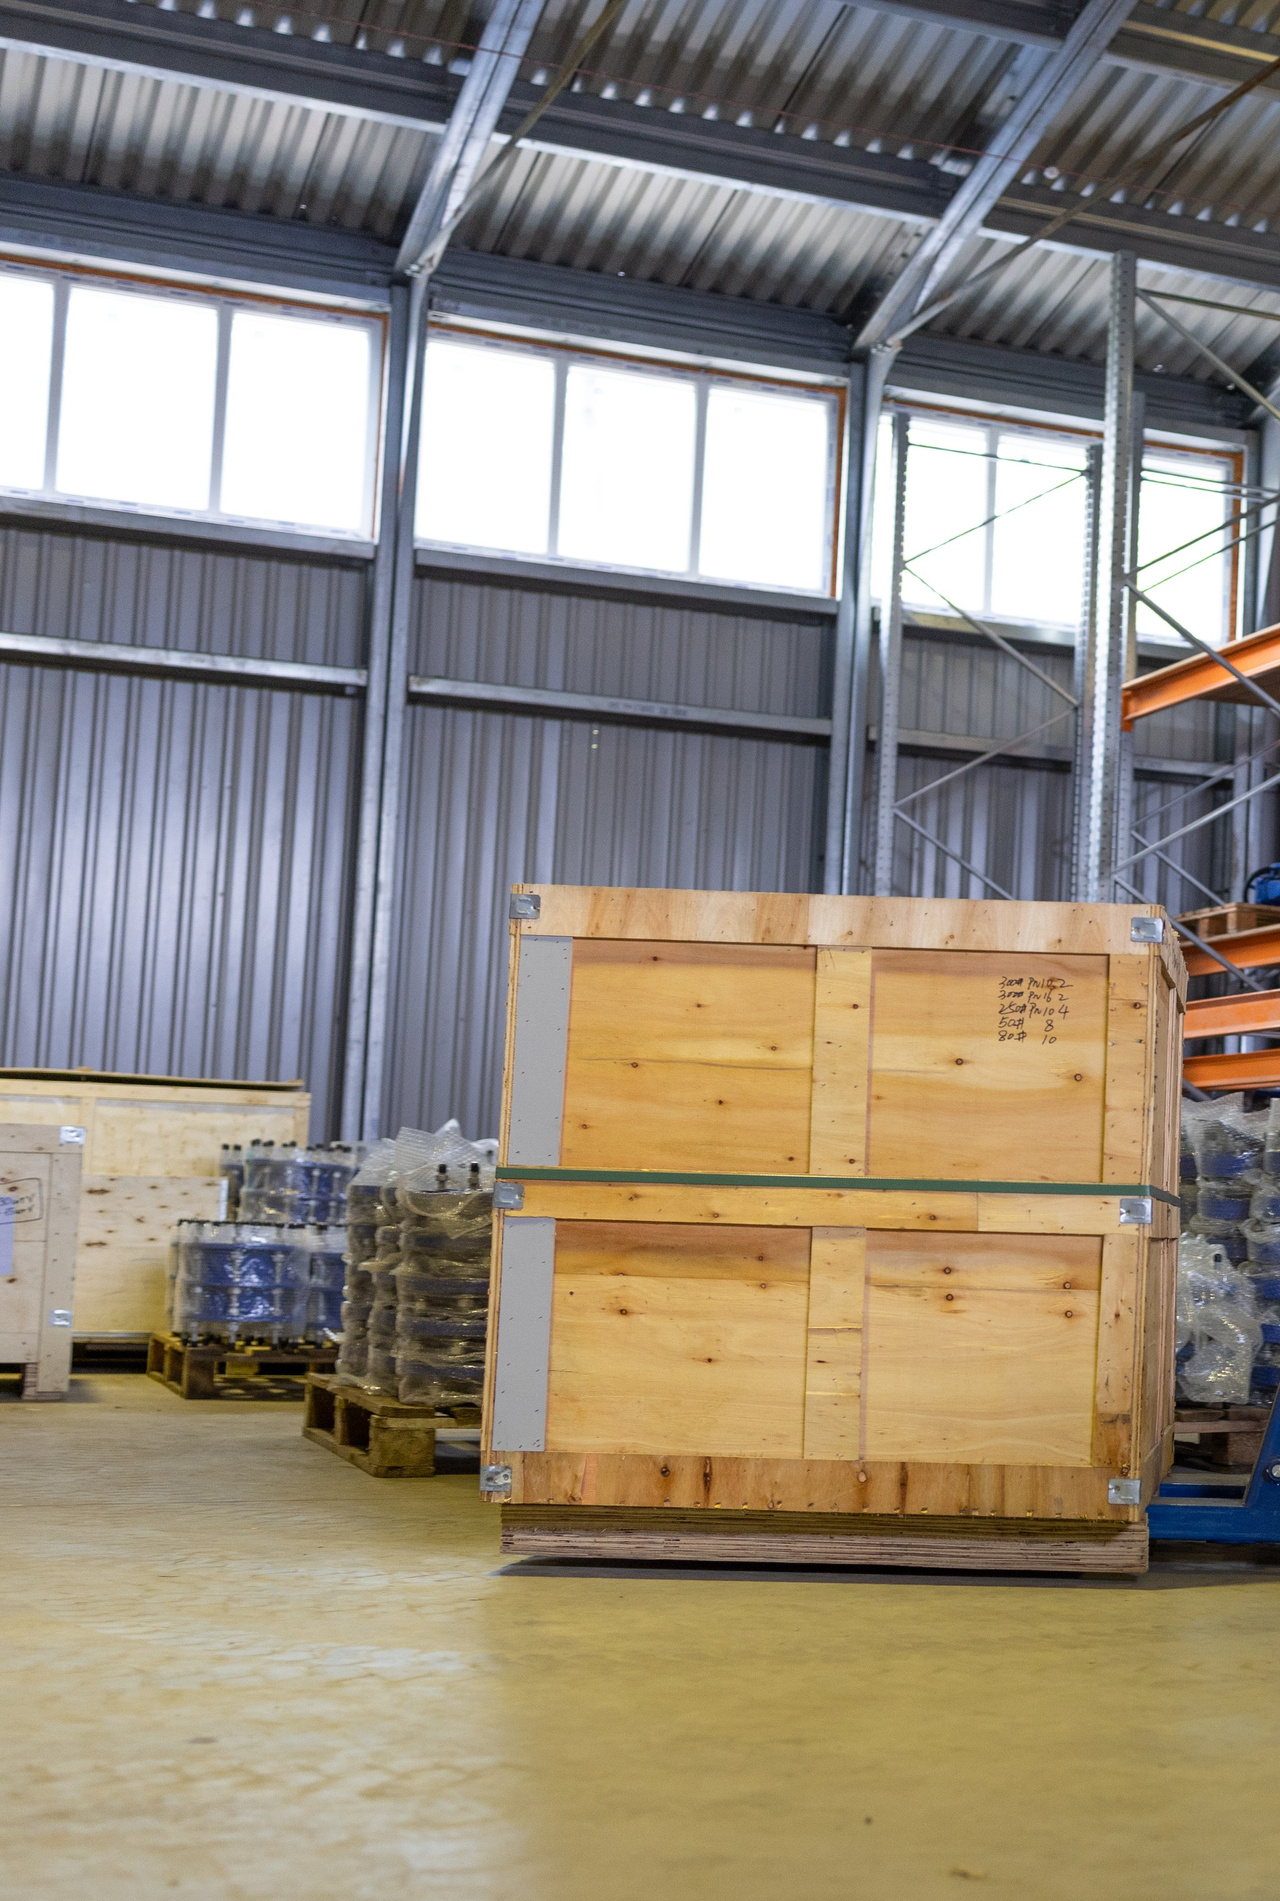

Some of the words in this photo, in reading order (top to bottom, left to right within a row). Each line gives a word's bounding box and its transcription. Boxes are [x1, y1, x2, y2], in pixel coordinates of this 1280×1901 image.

[1057, 978, 1074, 988] 2
[1058, 1004, 1069, 1020] 4
[1044, 1019, 1054, 1032] 8
[998, 1029, 1027, 1043] 80#
[1041, 1034, 1057, 1045] 10
